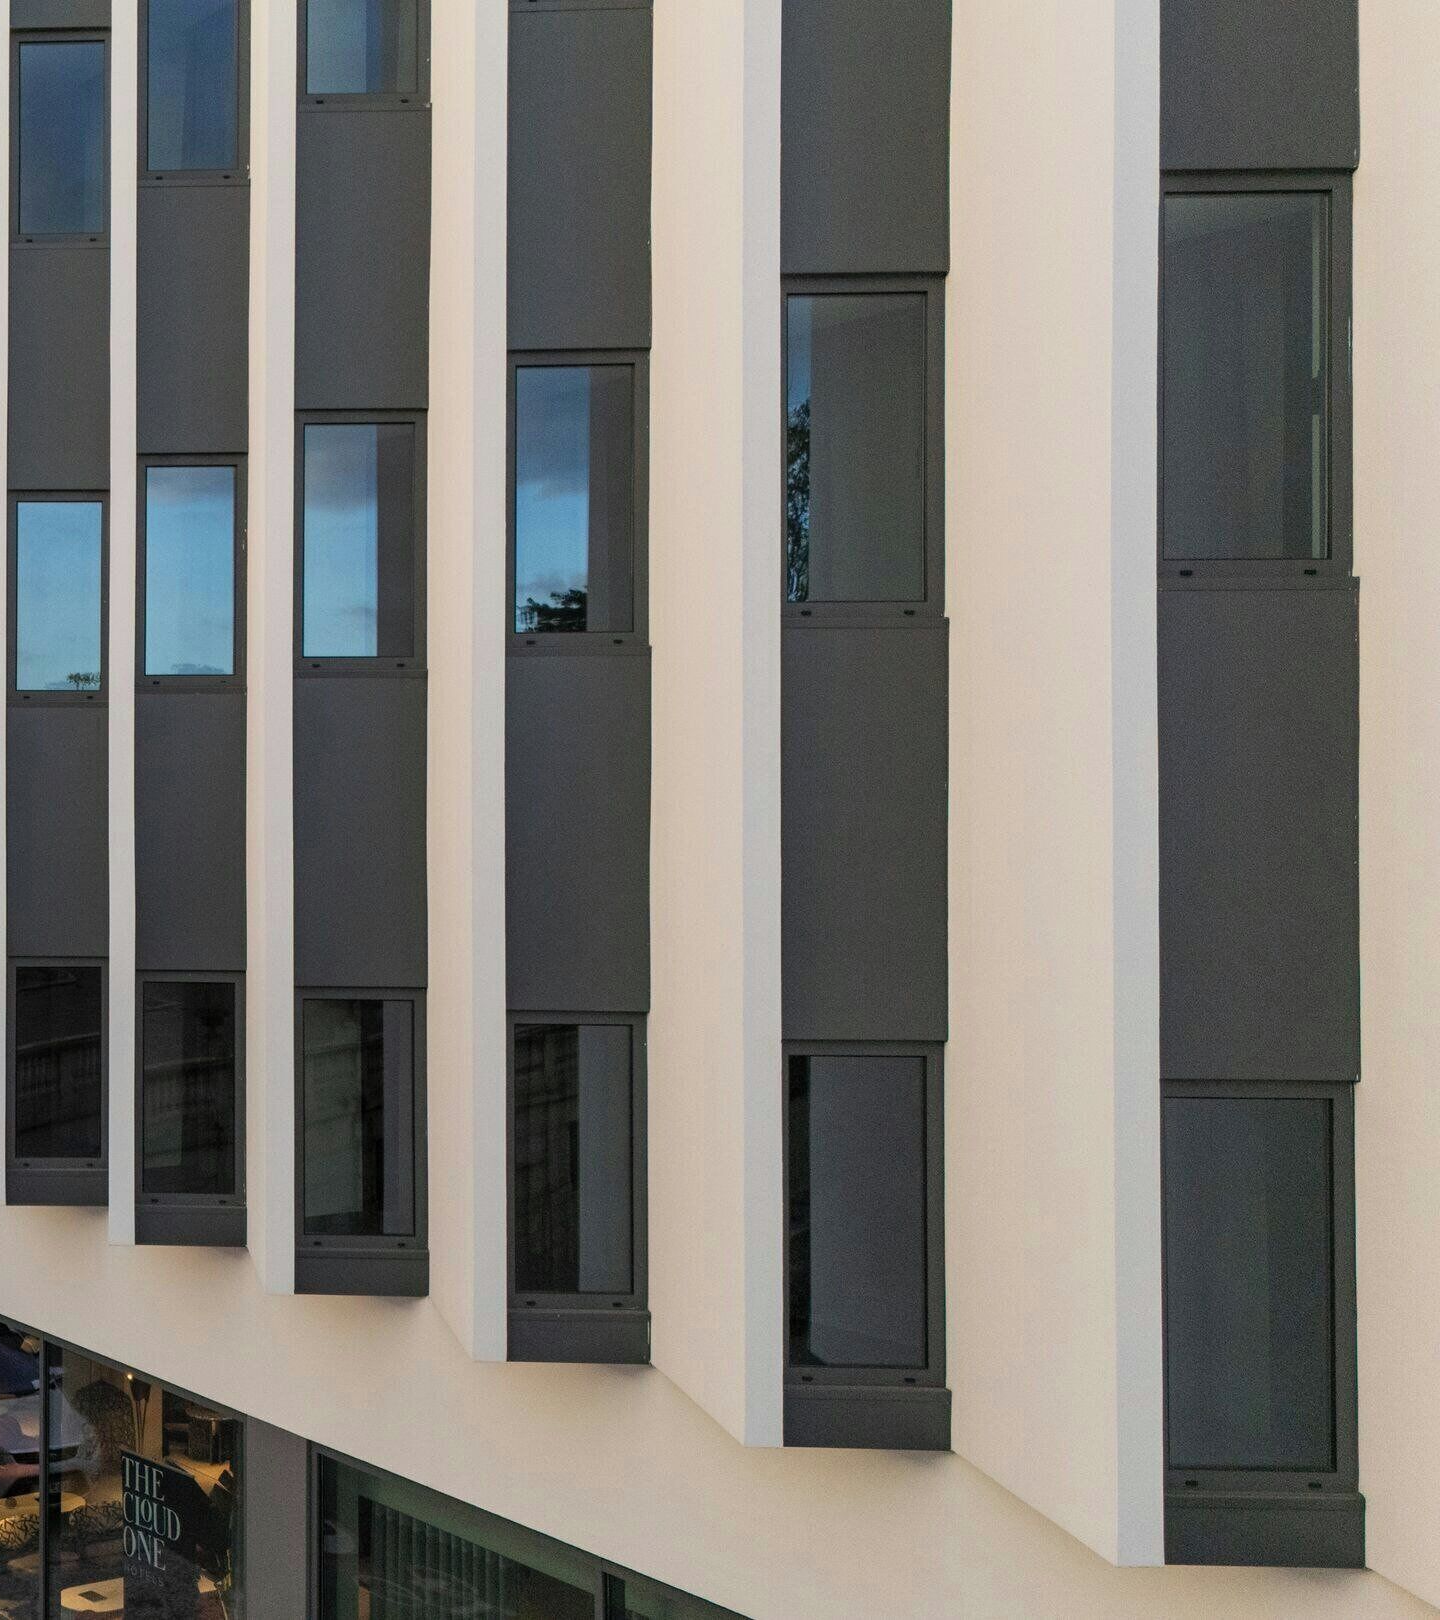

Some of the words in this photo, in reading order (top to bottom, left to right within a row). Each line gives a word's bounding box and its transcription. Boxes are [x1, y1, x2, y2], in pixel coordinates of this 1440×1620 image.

[122, 1456, 164, 1501] THE
[123, 1492, 181, 1541] CLOUD
[123, 1525, 166, 1571] ONE
